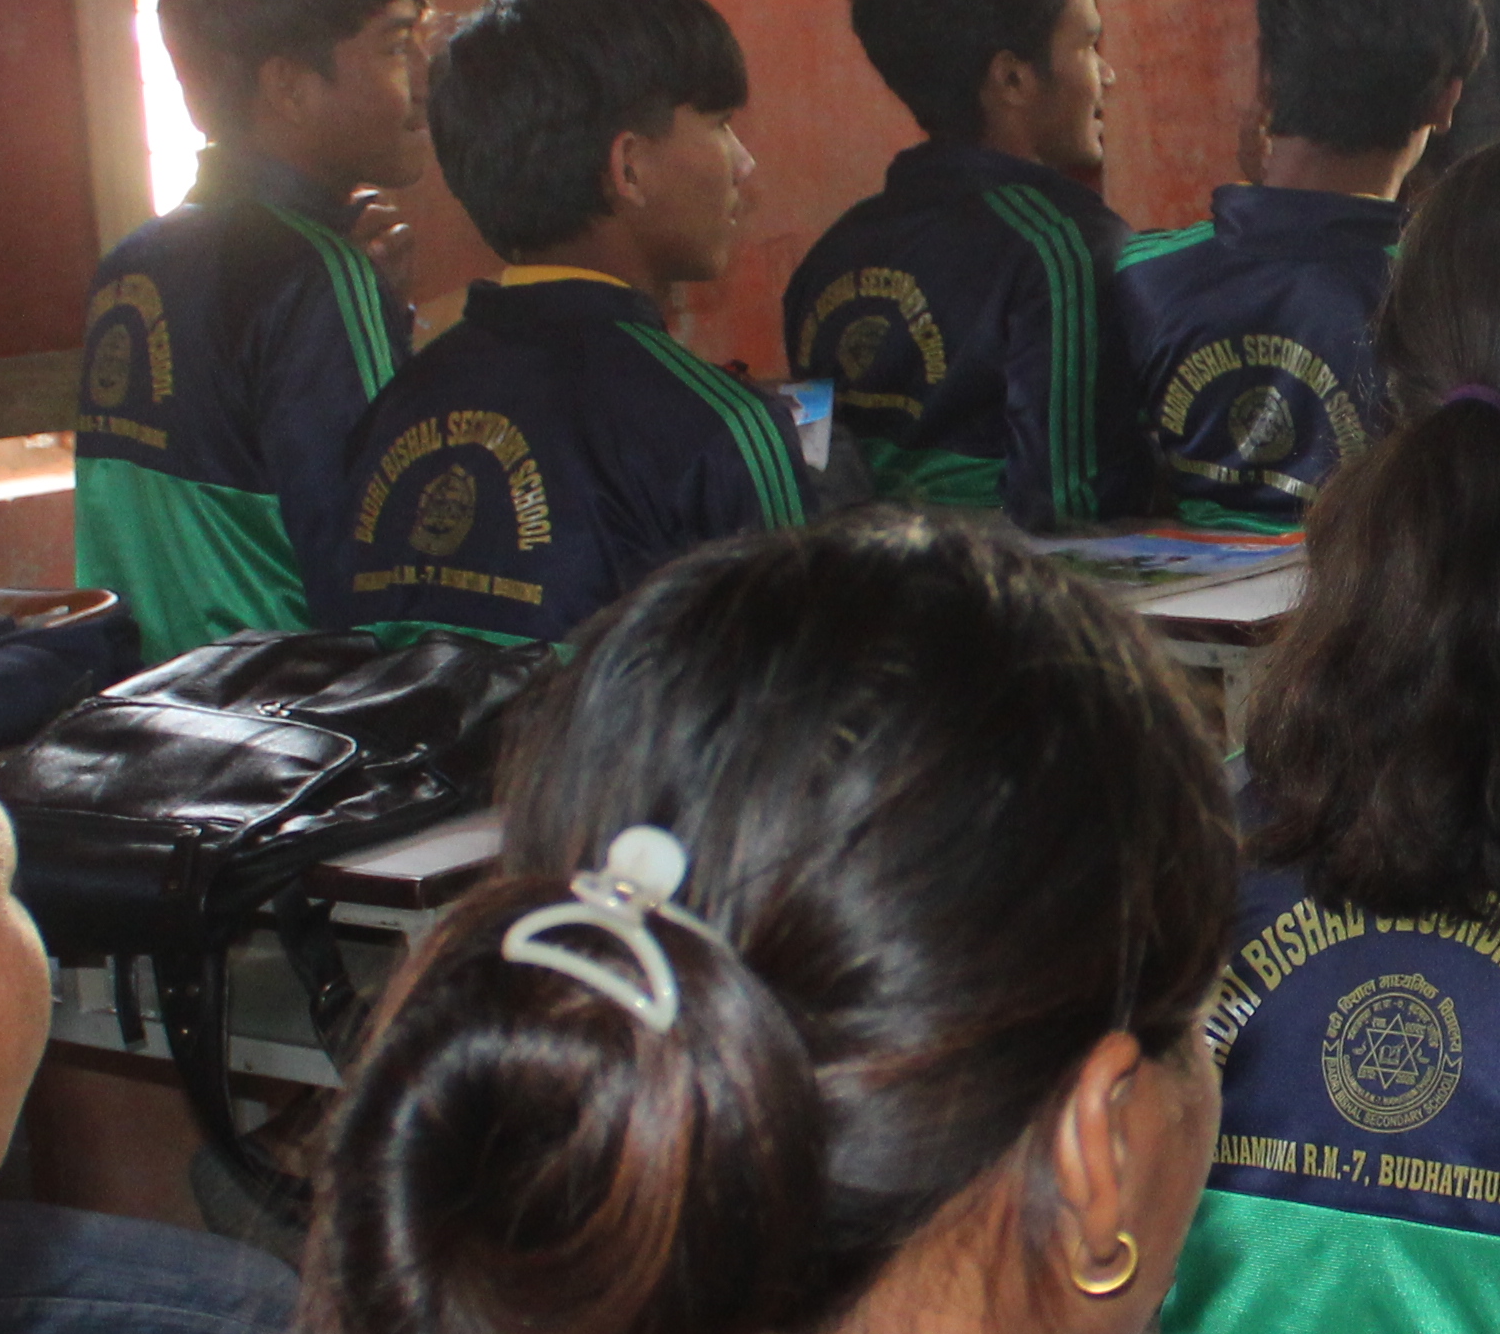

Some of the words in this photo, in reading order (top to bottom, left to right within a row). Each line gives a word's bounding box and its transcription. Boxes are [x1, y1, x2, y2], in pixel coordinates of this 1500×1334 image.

[508, 459, 552, 551] SCHOOL
[1202, 964, 1262, 1067] ADRI
[1240, 896, 1365, 992] BISHAL
